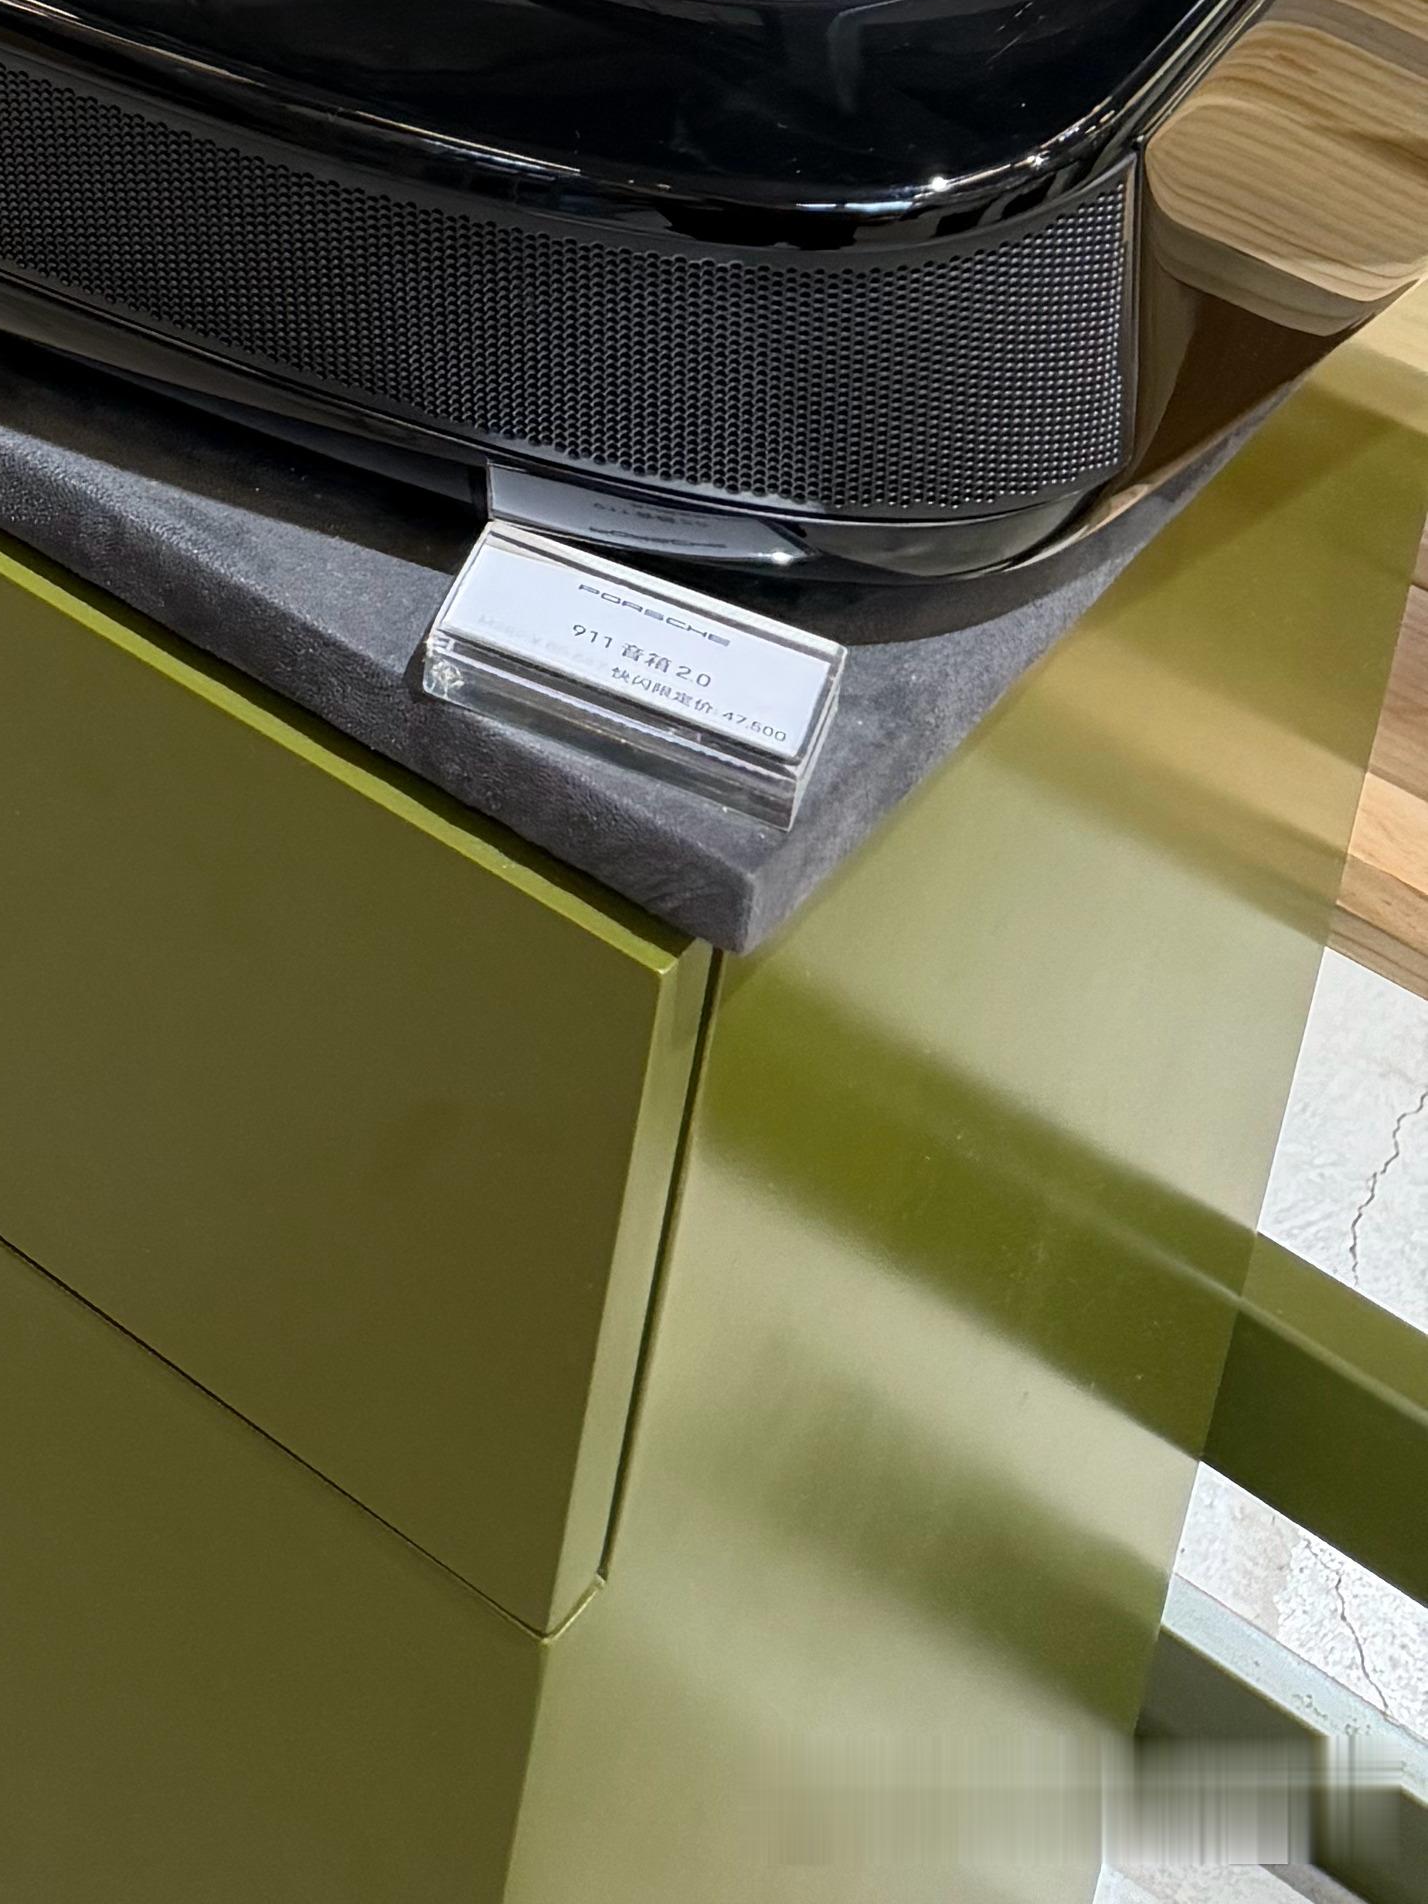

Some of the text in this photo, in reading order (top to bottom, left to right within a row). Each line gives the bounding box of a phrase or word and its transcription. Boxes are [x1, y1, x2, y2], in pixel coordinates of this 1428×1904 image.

[577, 583, 731, 647] PORSCHE
[572, 624, 613, 649] 911
[676, 665, 712, 689] 2.0
